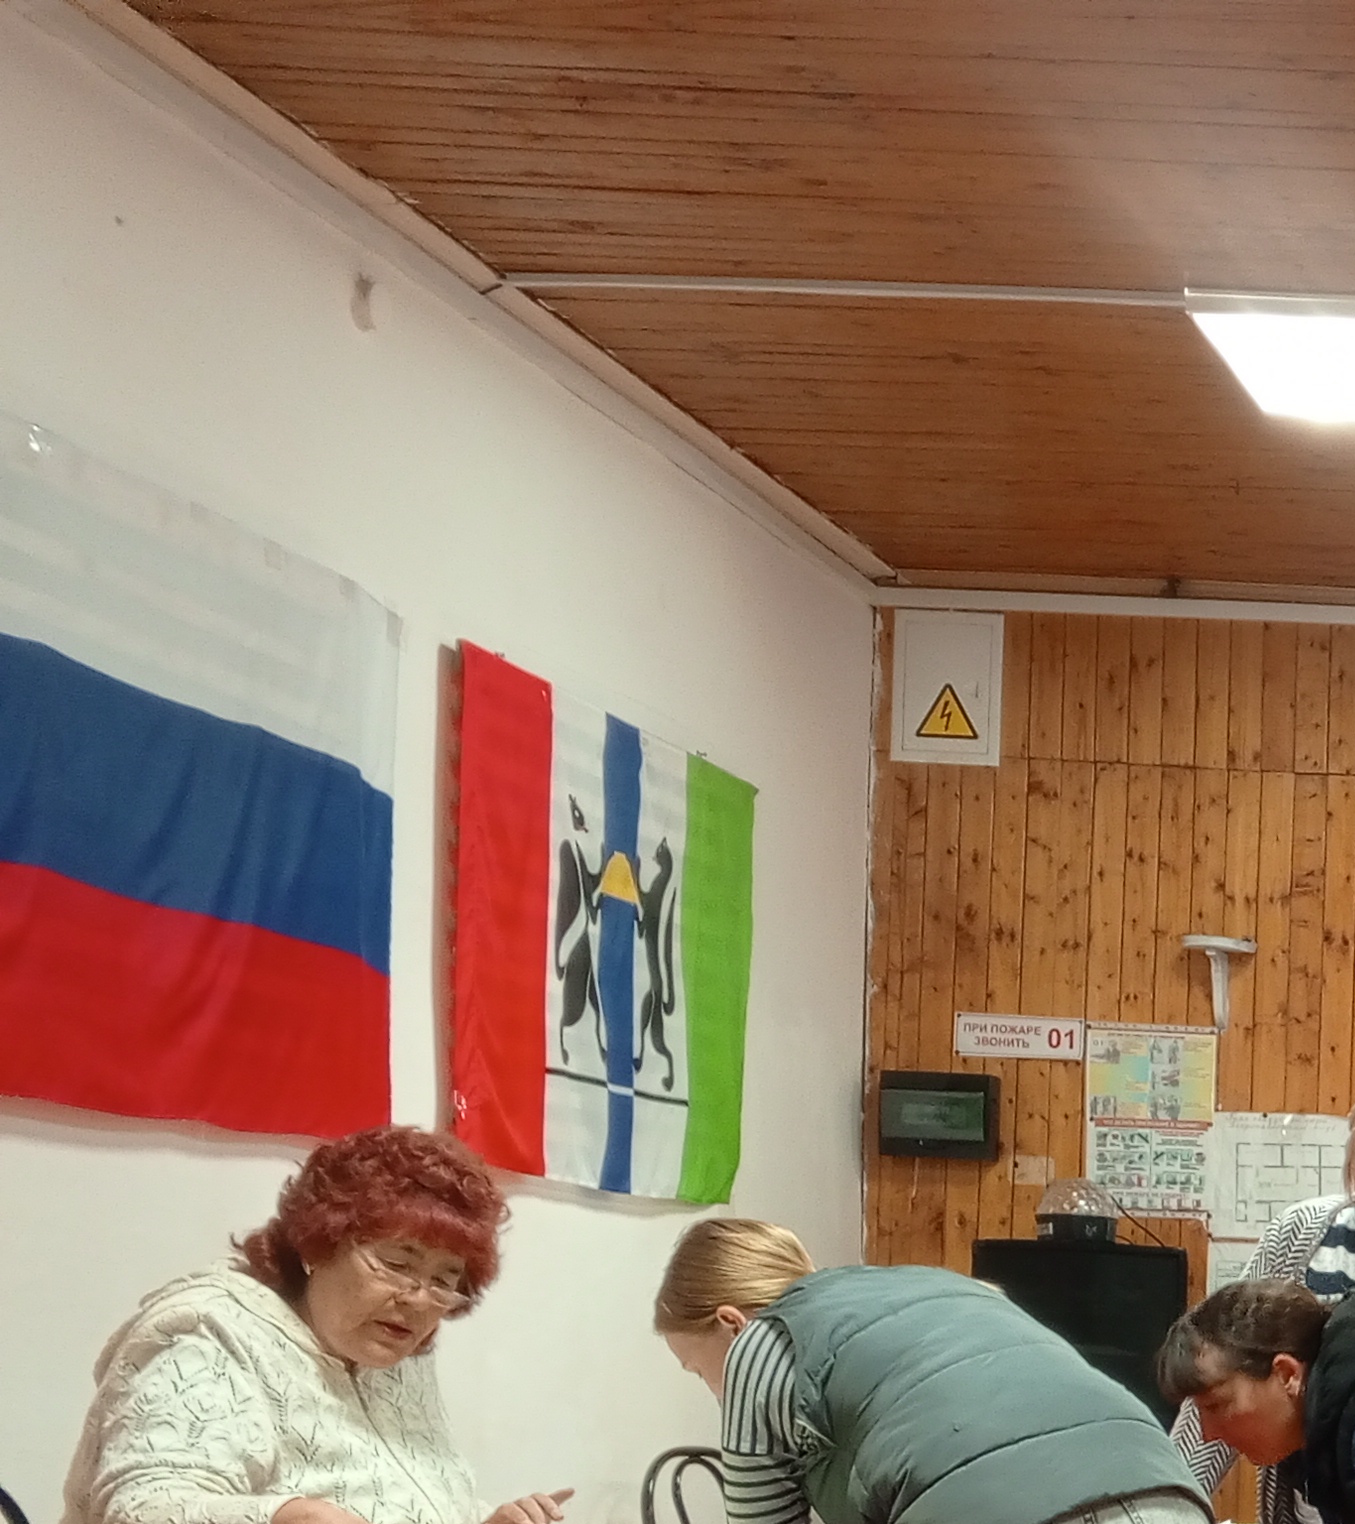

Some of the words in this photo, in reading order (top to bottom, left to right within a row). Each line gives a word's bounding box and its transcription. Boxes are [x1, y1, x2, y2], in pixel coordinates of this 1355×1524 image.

[963, 1022, 987, 1033] ПРИ
[990, 1024, 1042, 1036] ПОЖАРЕ
[974, 1036, 1030, 1048] ЗВОНИТЬ
[1047, 1028, 1075, 1050] 01
